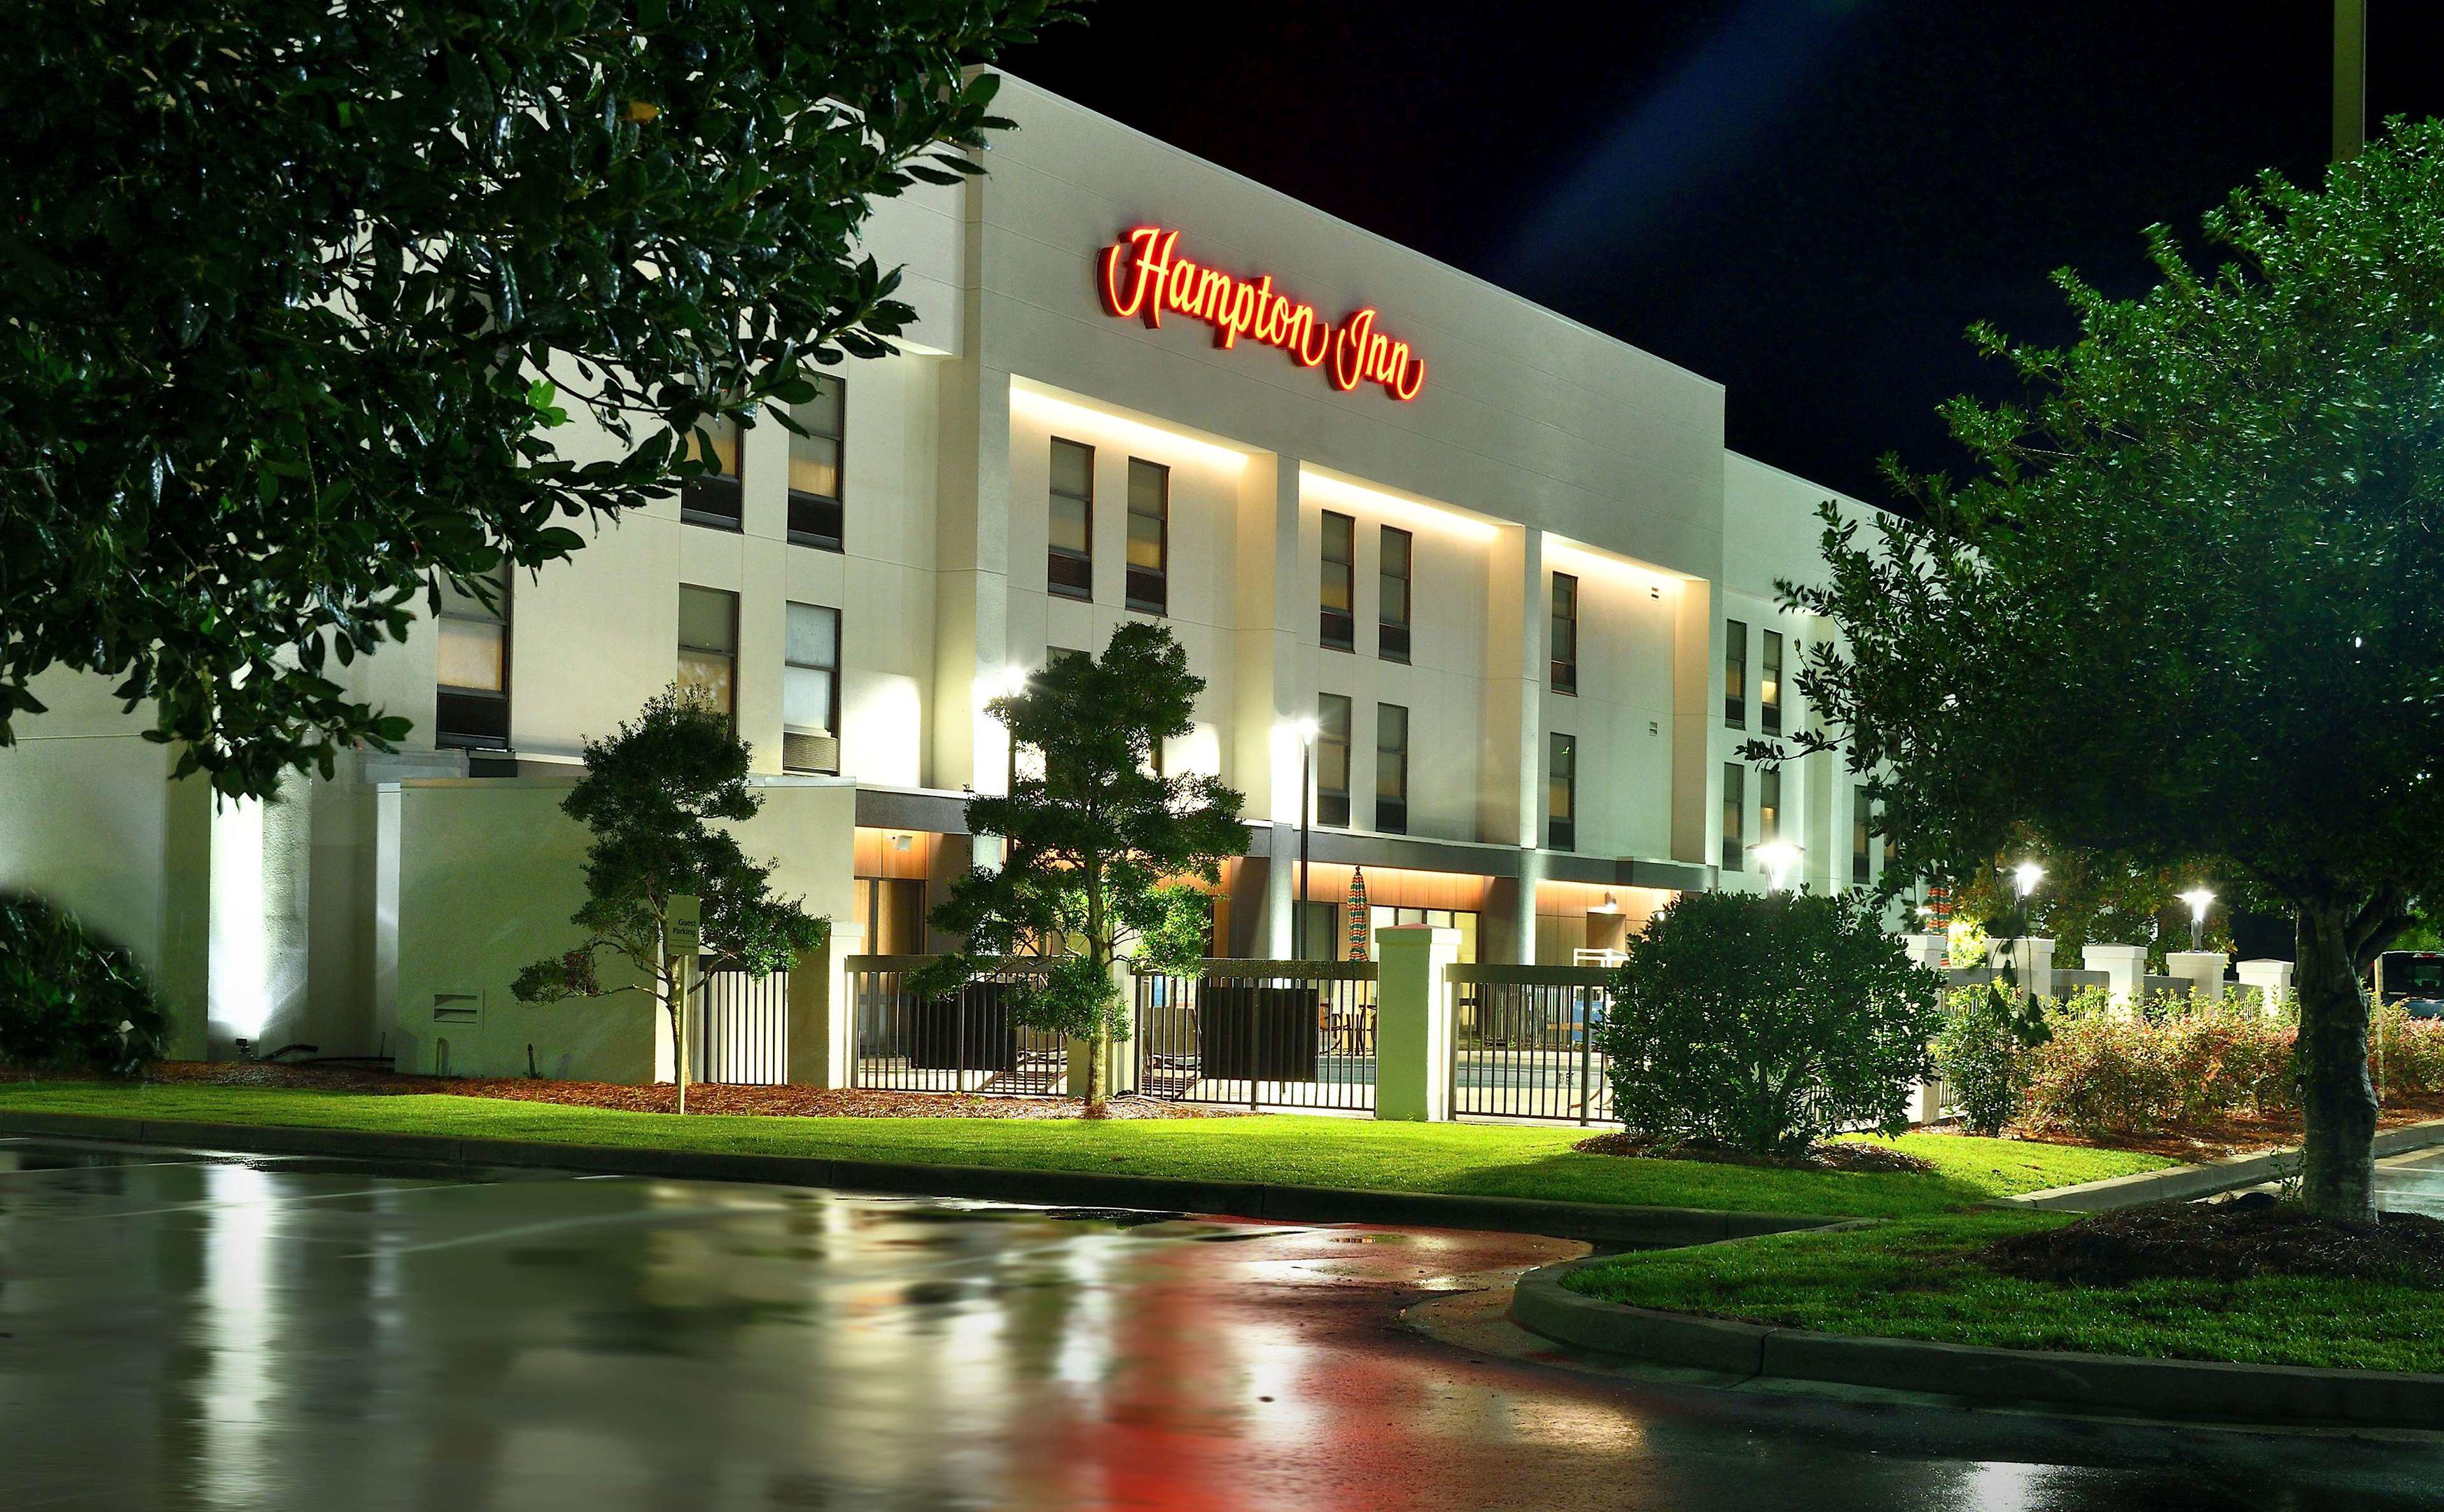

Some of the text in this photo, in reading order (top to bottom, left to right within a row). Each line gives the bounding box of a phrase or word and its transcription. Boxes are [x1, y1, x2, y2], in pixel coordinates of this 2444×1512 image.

[1101, 226, 1424, 400] Hampton Inn
[678, 918, 697, 927] Guest
[673, 927, 696, 937] Parking
